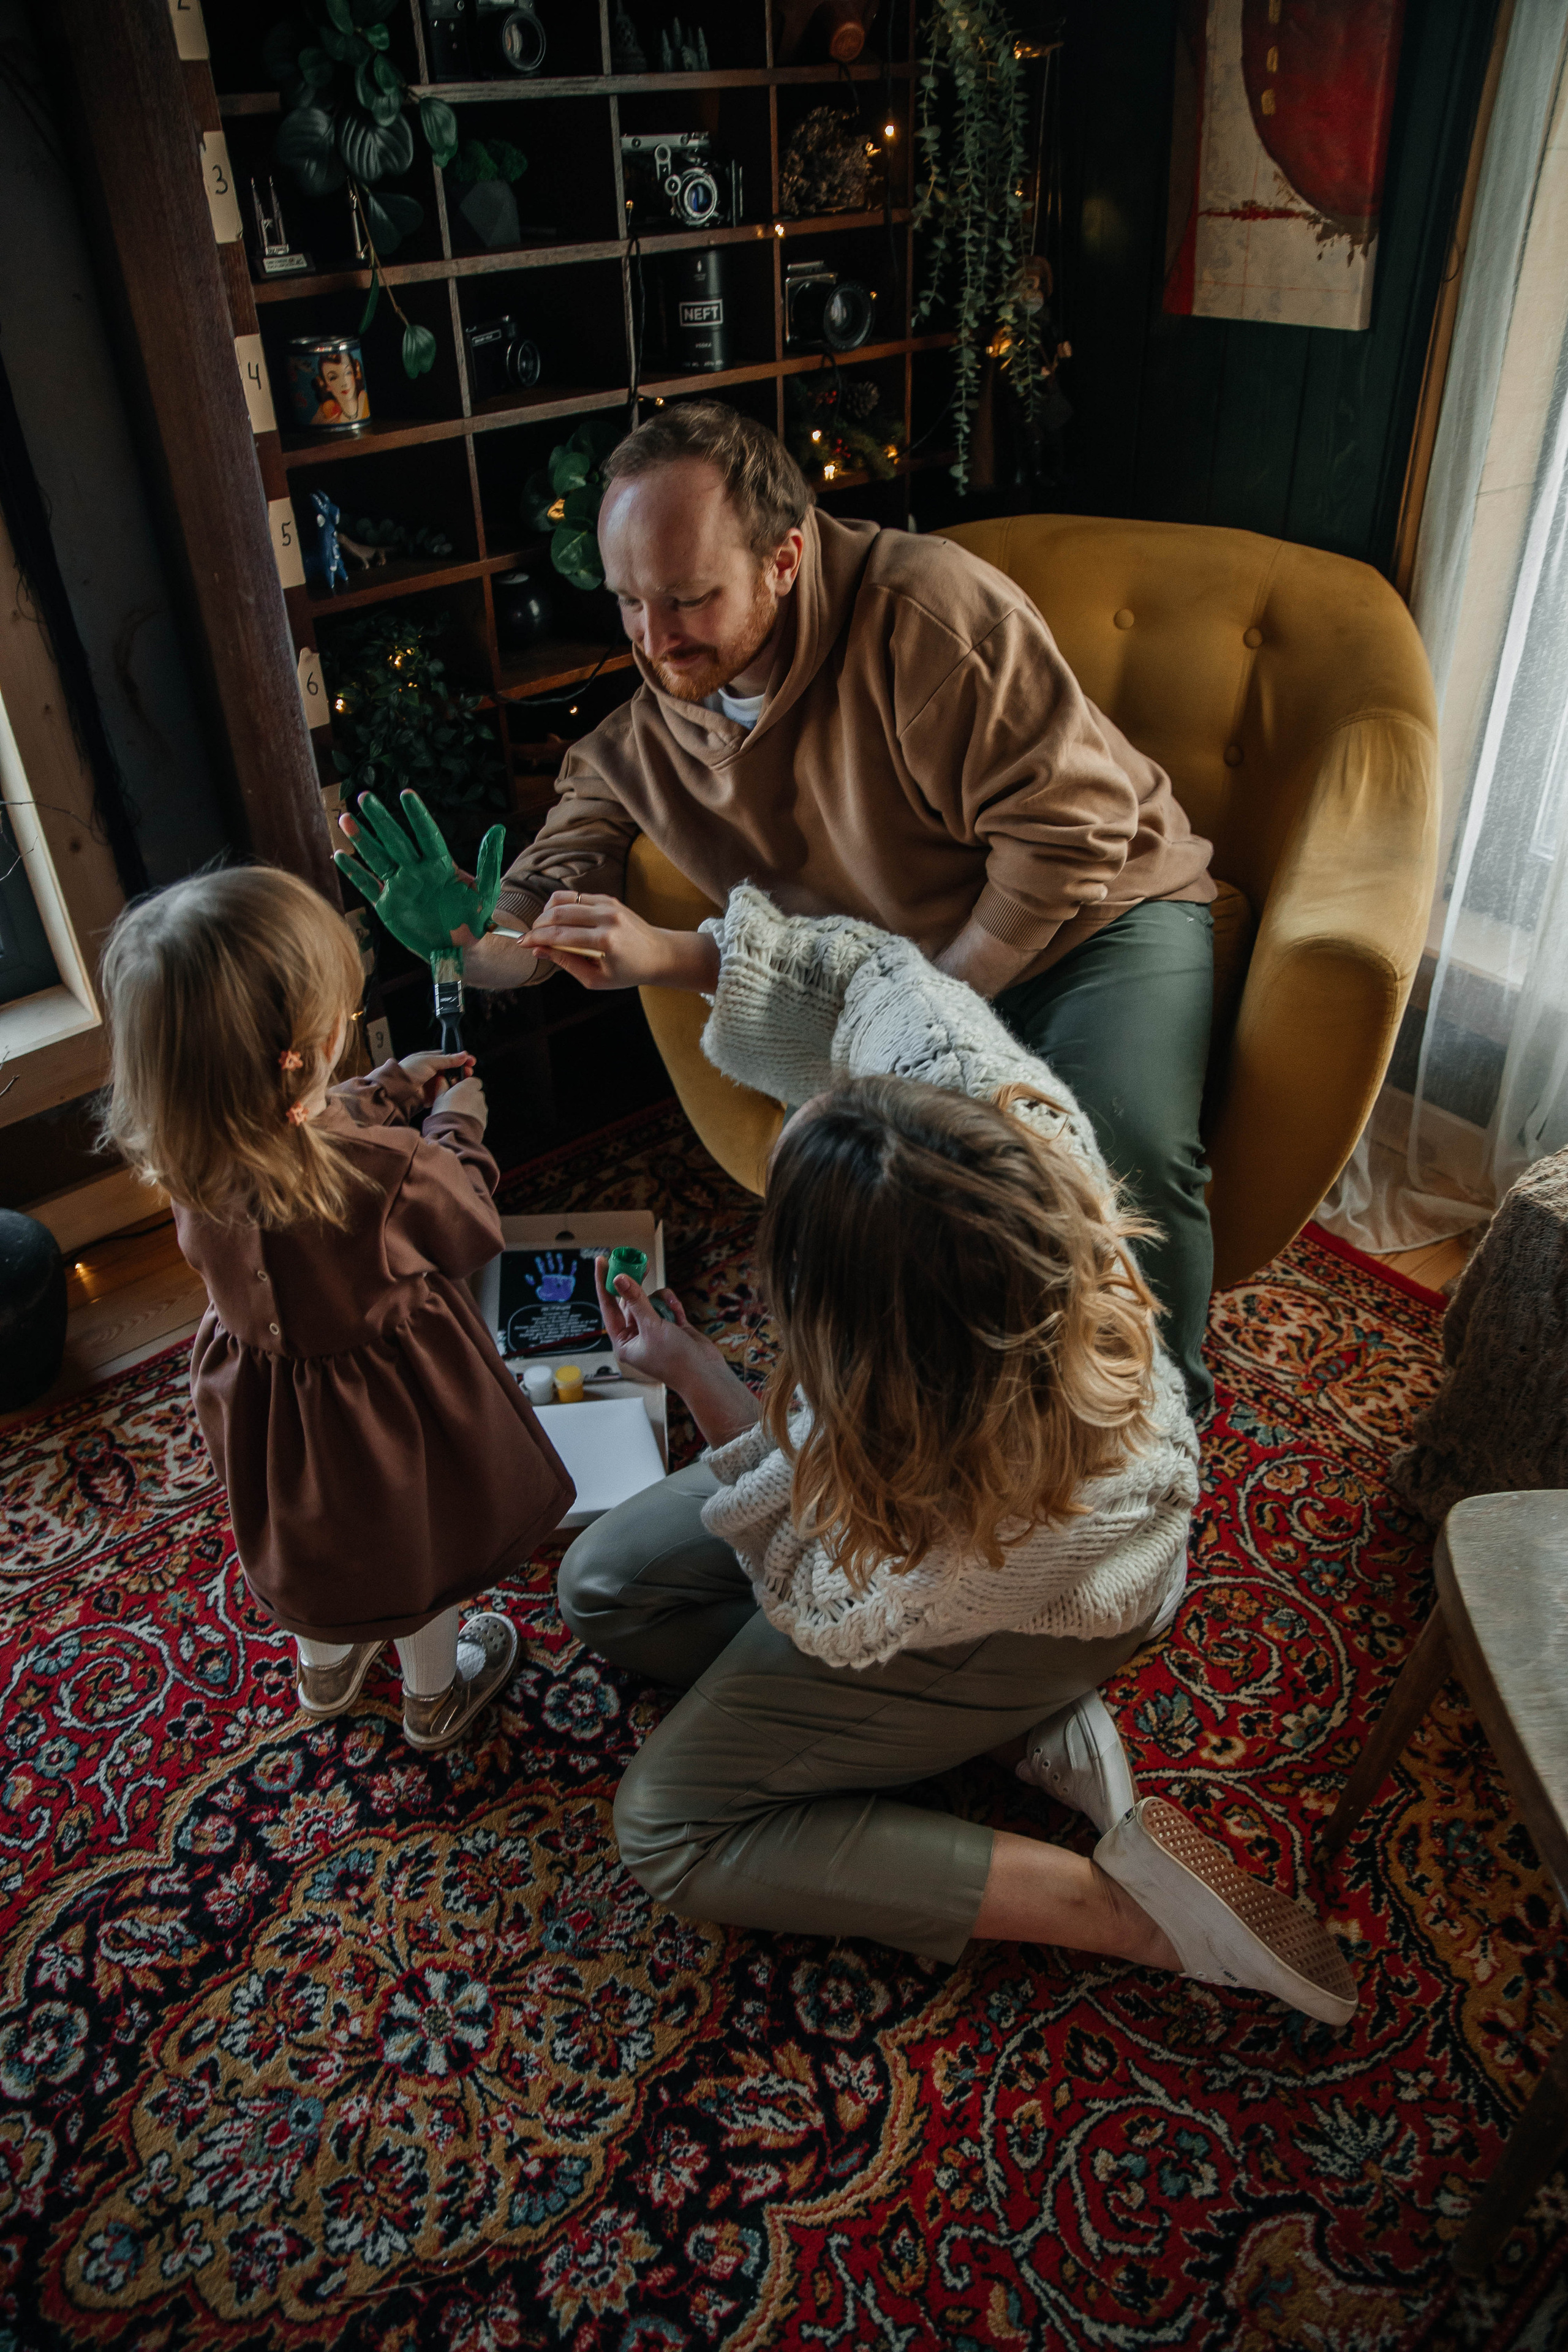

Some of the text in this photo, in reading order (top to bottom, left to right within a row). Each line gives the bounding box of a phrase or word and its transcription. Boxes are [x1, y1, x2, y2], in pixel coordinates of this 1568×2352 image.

[212, 164, 228, 195] 3
[684, 305, 719, 322] NEFT
[247, 361, 262, 390] 4
[281, 521, 292, 546] 5
[307, 671, 318, 696] 6
[375, 1031, 384, 1049] 9
